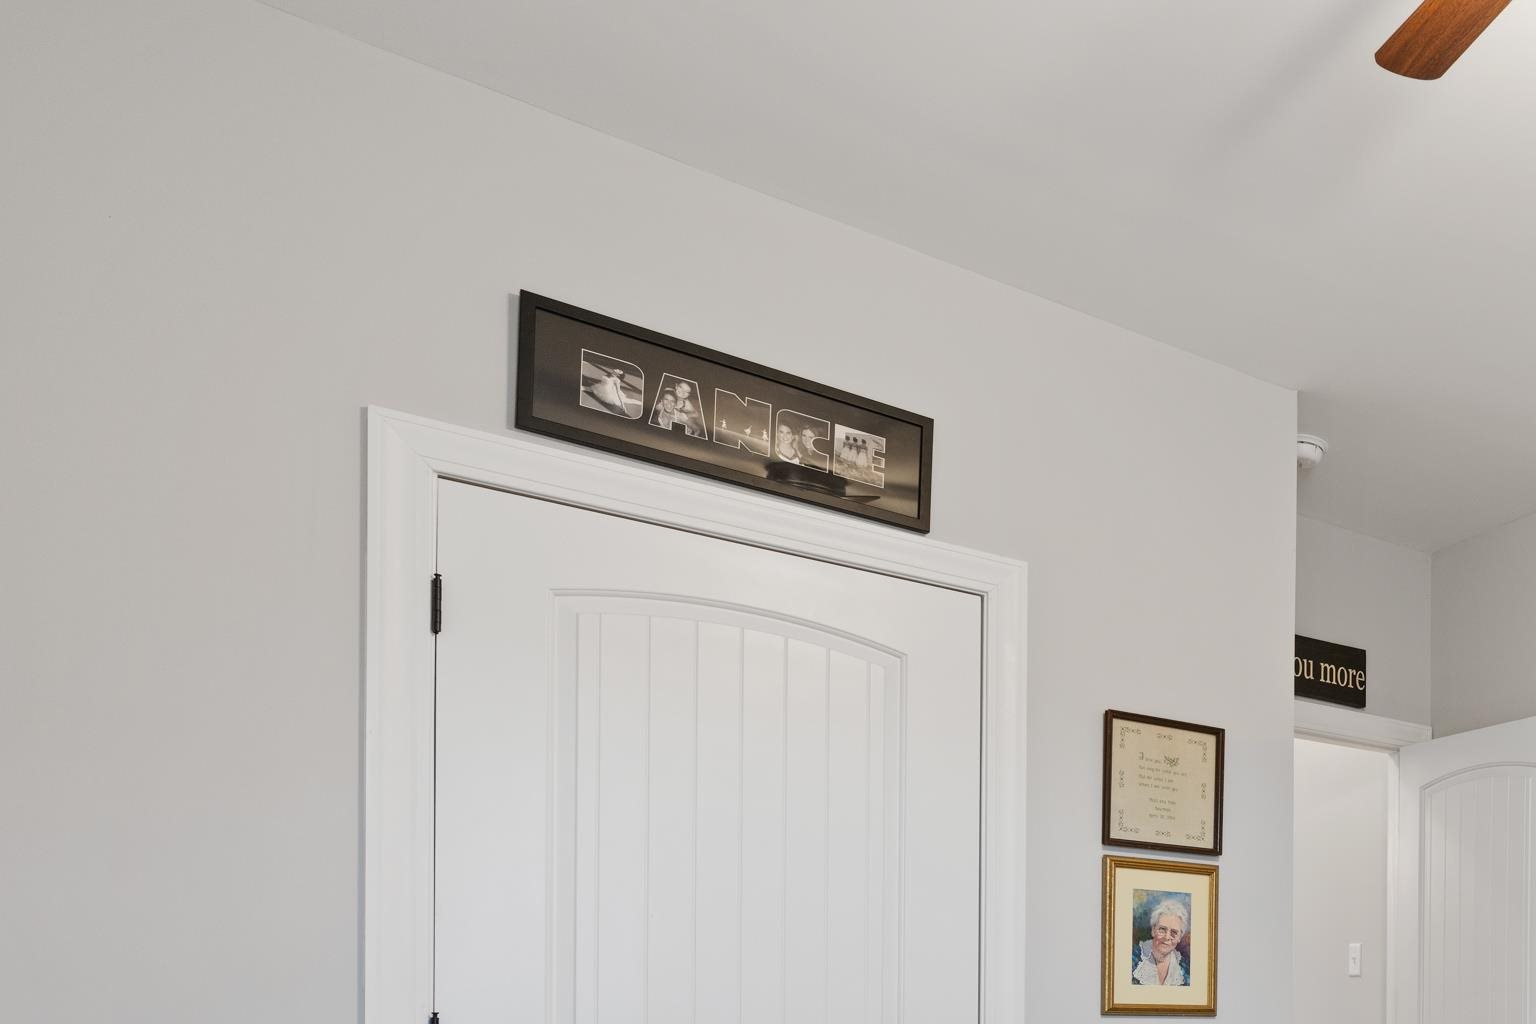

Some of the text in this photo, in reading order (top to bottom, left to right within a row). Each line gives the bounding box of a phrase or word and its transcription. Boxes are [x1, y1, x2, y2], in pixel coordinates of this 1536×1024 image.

[578, 347, 887, 489] DANCE
[1294, 657, 1365, 691] ou more
